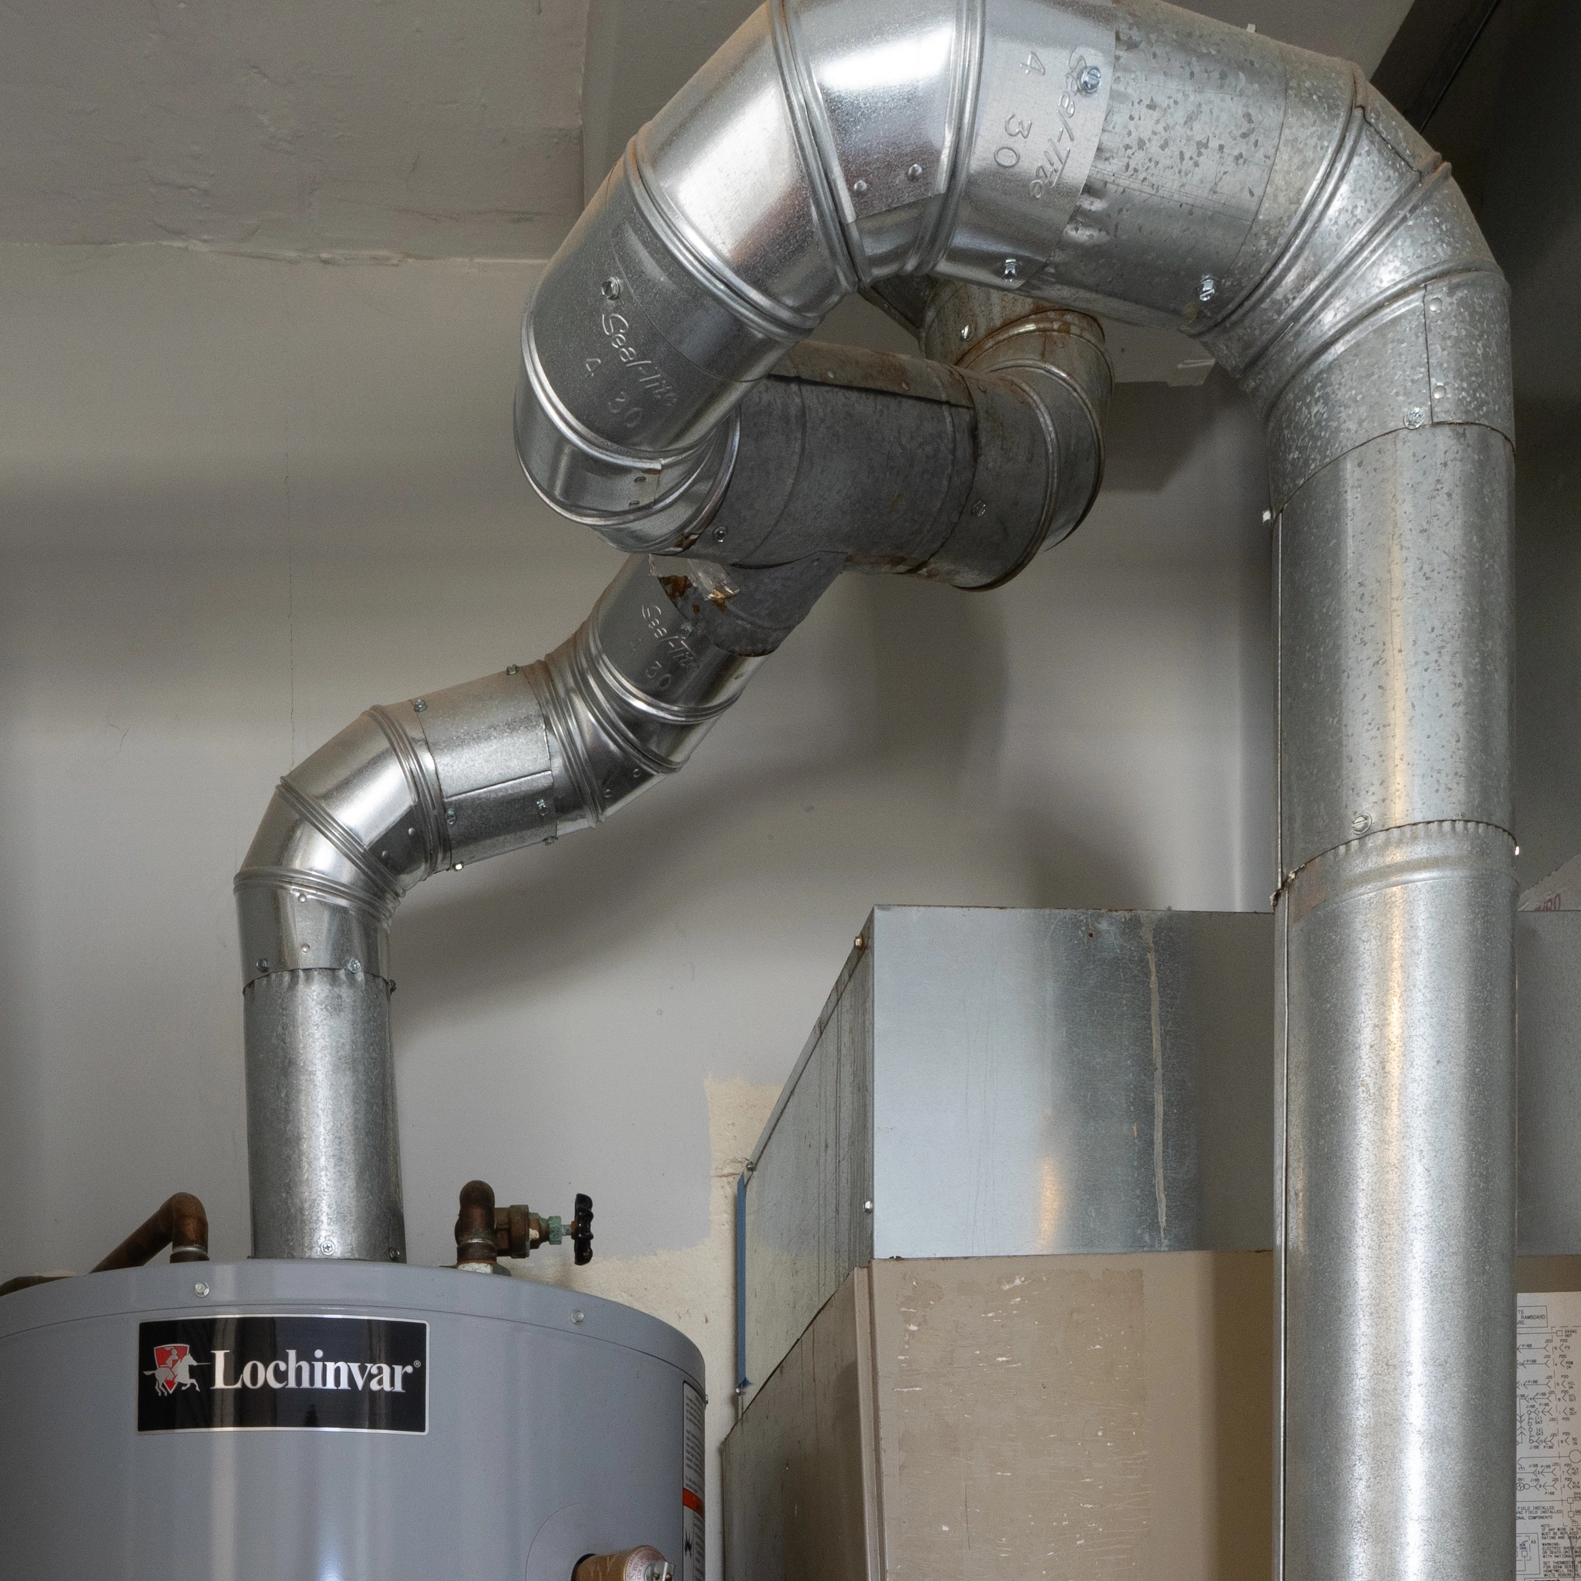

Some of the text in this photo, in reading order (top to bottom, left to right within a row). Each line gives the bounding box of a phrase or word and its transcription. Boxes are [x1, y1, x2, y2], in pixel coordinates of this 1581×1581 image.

[993, 50, 1046, 169] 4 30
[210, 1349, 413, 1392] Lochinvar
